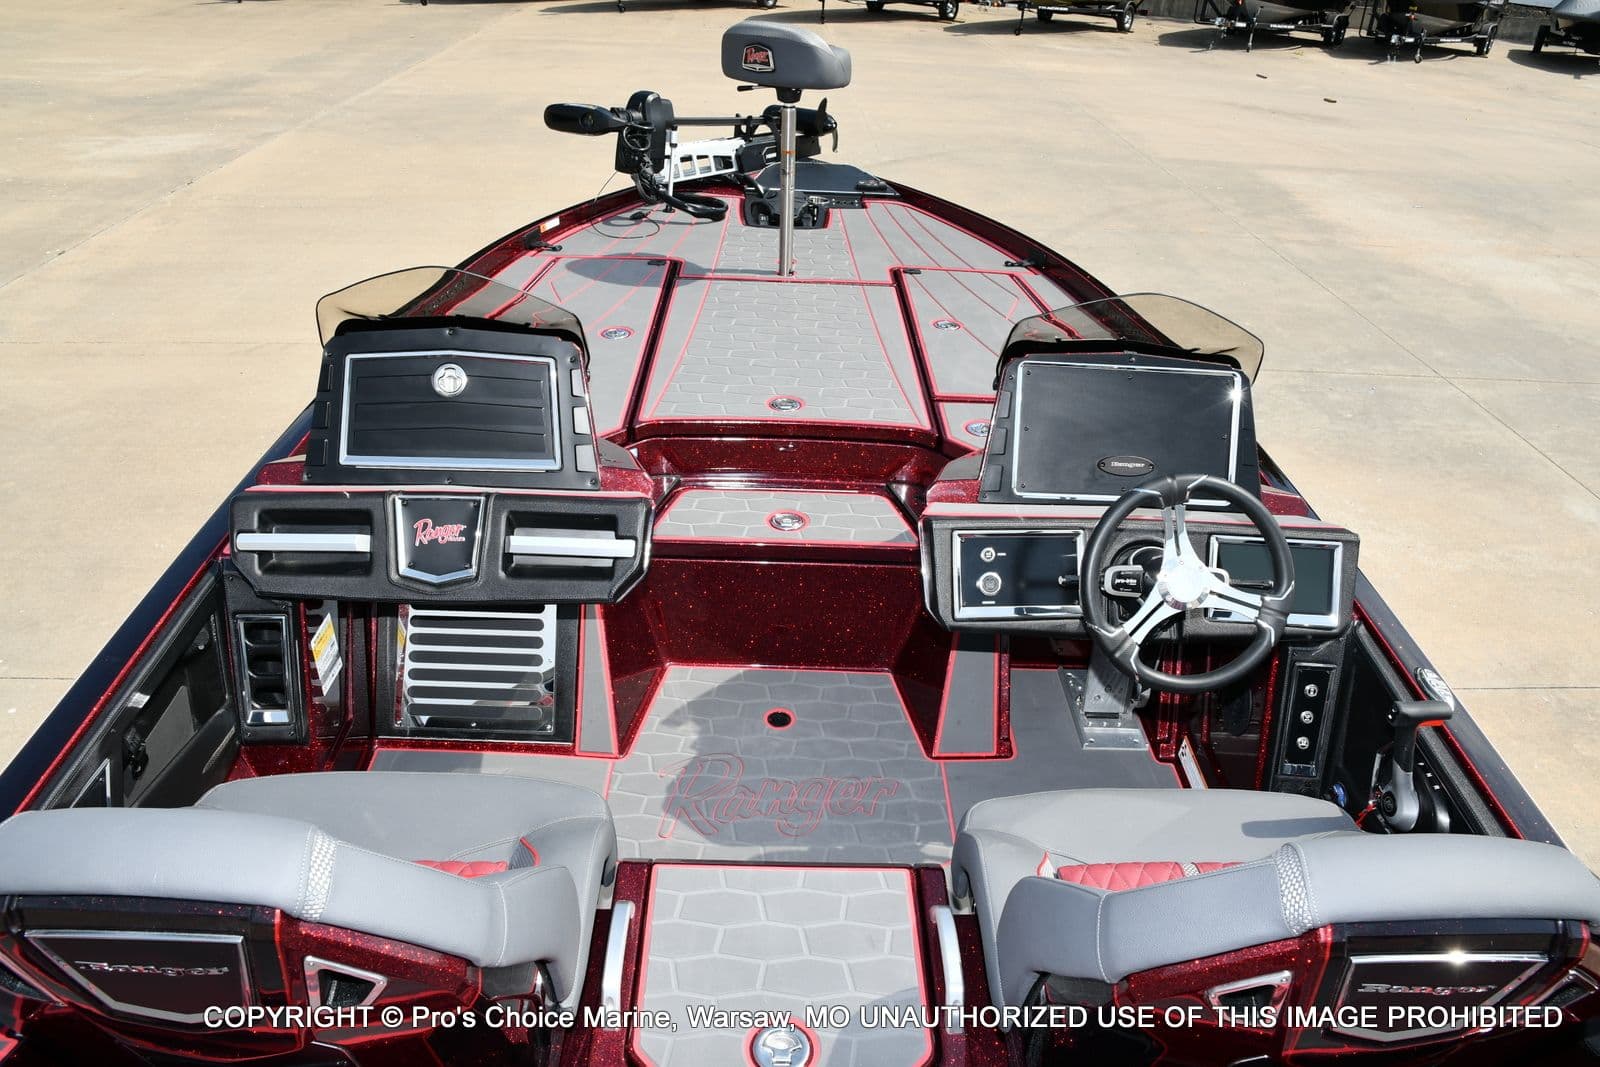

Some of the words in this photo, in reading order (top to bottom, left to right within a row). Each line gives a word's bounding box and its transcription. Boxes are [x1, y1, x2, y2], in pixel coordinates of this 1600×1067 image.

[412, 518, 467, 547] Ranger
[656, 752, 902, 841] Ranger
[74, 960, 230, 977] Ranger
[1356, 982, 1498, 996] Ranger
